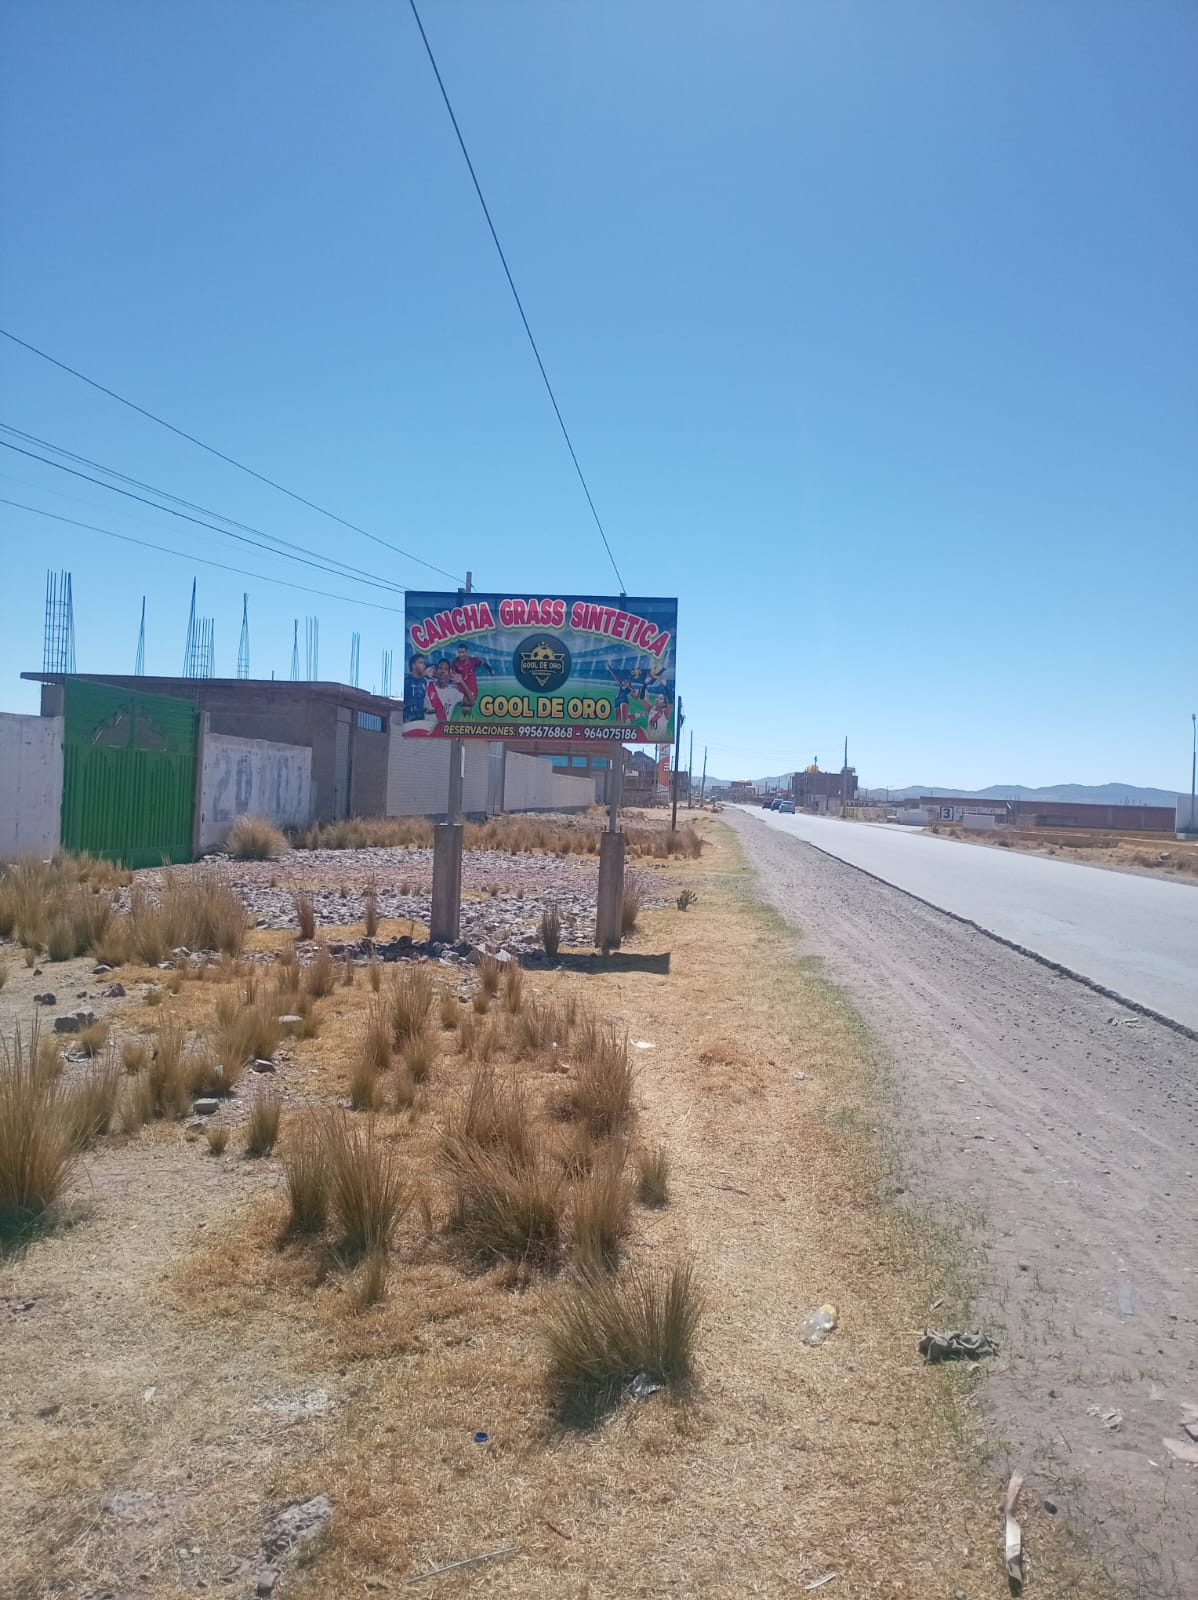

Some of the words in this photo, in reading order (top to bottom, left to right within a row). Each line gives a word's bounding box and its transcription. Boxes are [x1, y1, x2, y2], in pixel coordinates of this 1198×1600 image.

[411, 602, 495, 650] CANCHA
[500, 599, 566, 628] GRASS
[569, 601, 671, 659] SINTETICA
[522, 662, 538, 670] GOOL
[540, 662, 548, 670] DE
[480, 695, 534, 717] GOOL
[537, 697, 564, 718] DE
[568, 698, 611, 719] ORO
[443, 725, 516, 736] RESERVACIONES:
[518, 726, 573, 738] 995676868
[583, 728, 638, 740] 964075186
